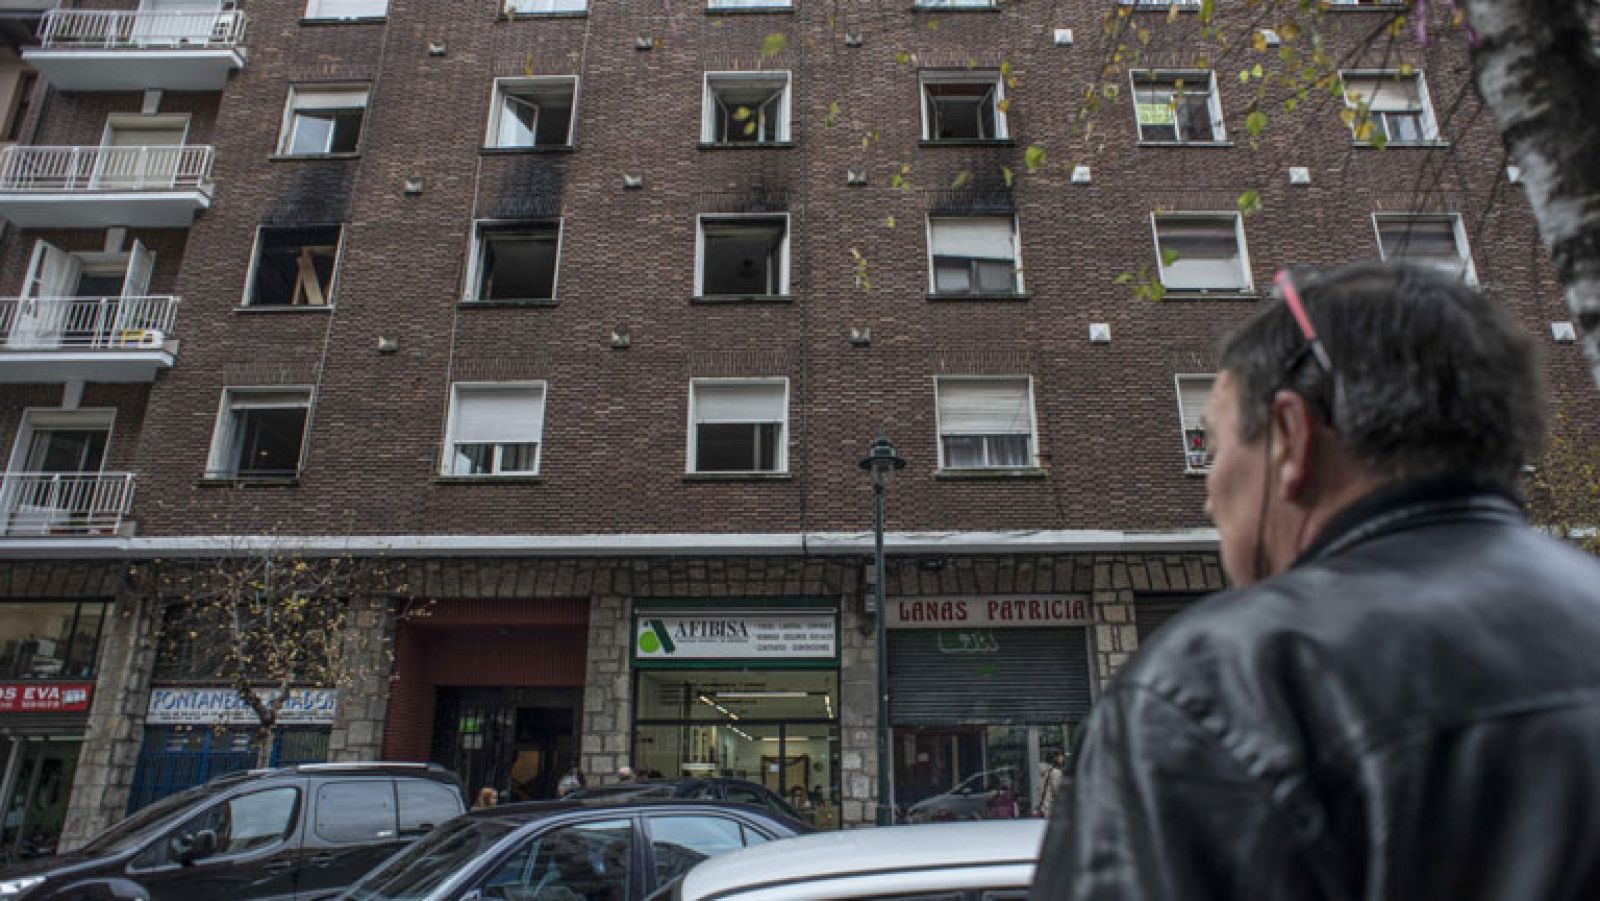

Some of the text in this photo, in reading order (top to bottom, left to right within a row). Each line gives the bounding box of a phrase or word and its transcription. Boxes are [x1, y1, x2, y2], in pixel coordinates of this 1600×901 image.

[899, 600, 1085, 622] LANAS PATRICIA
[24, 687, 59, 700] EVA
[153, 690, 252, 710] FONTANE
